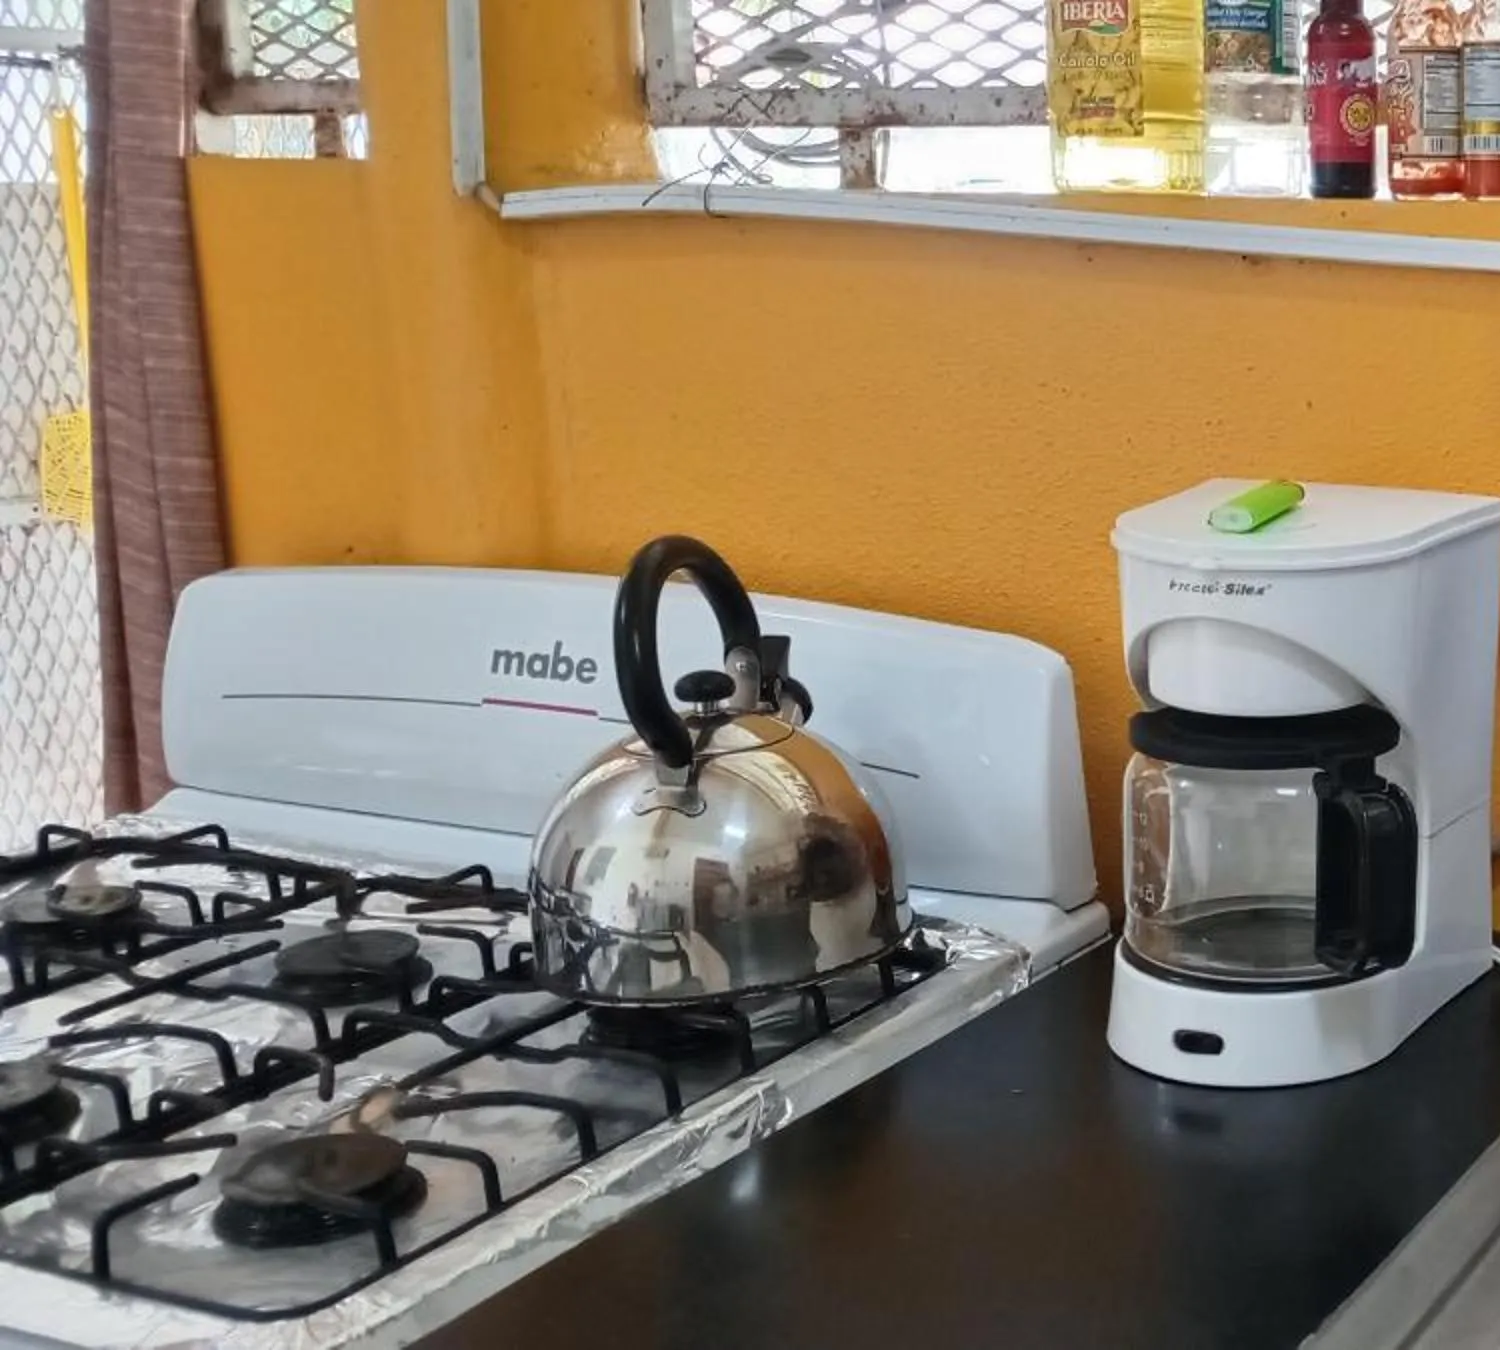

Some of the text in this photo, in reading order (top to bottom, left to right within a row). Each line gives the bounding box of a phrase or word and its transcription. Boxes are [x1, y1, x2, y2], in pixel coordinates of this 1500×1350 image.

[1063, 1, 1125, 20] IBERIA
[1113, 50, 1136, 67] Oil
[491, 639, 598, 684] mabe
